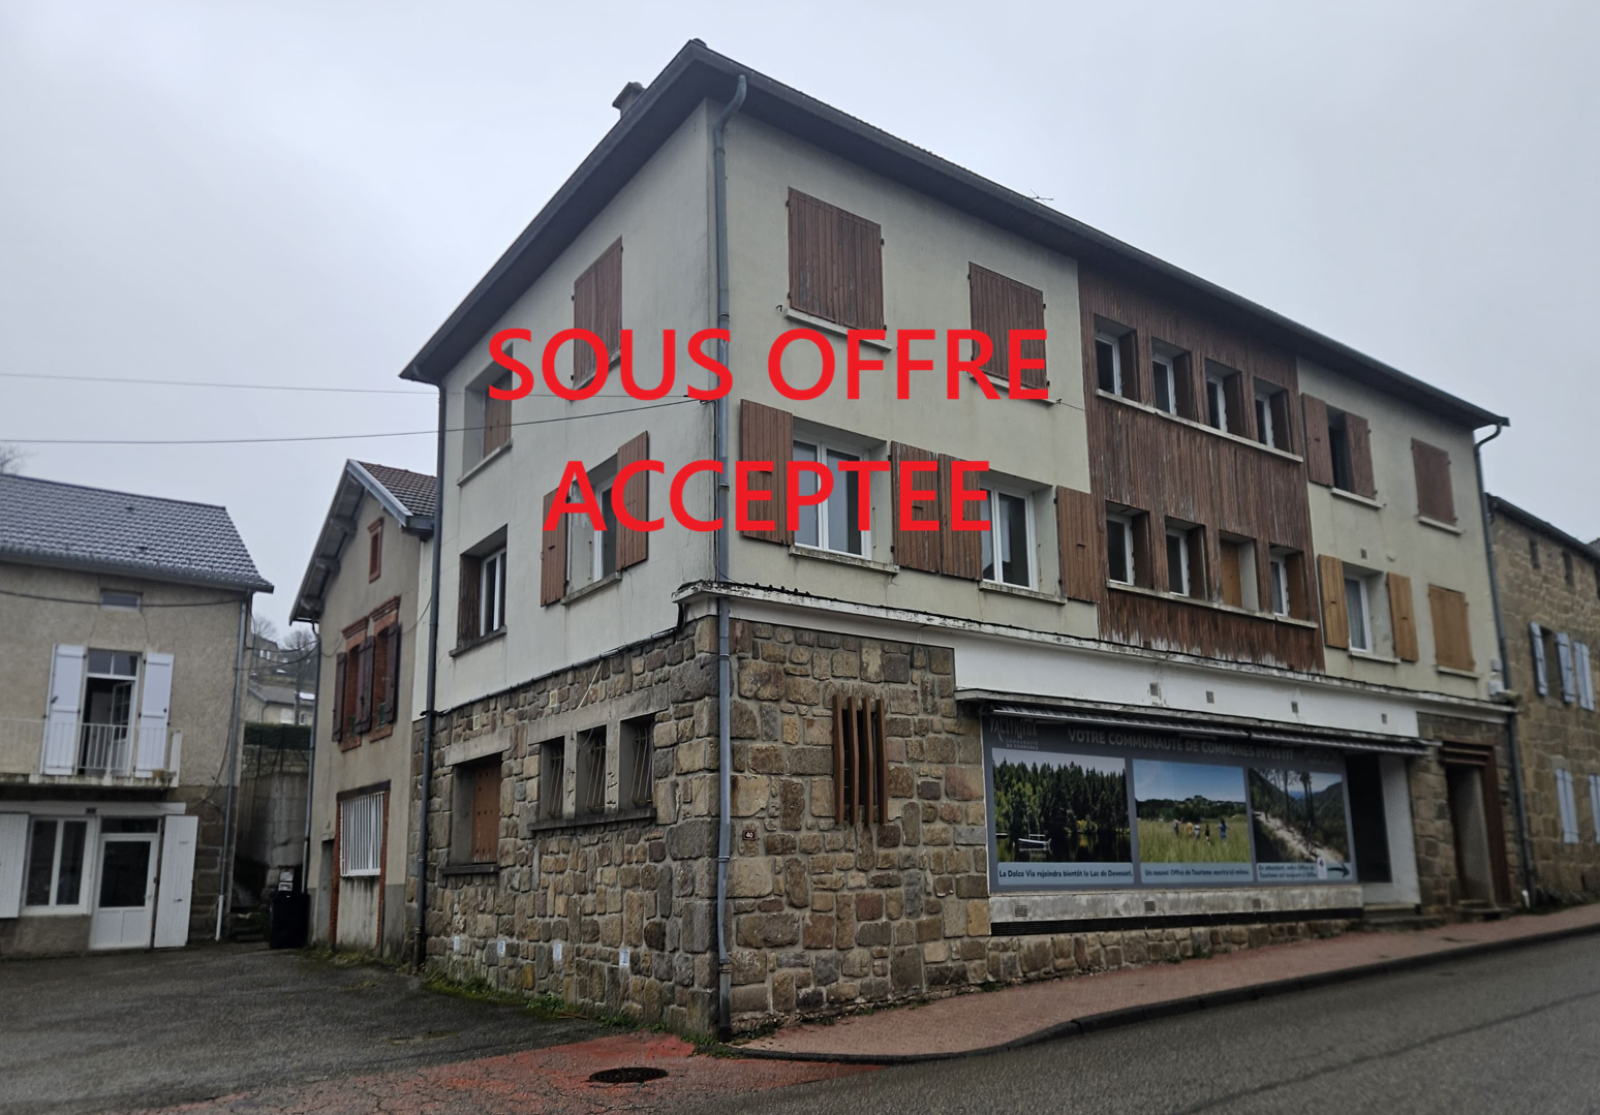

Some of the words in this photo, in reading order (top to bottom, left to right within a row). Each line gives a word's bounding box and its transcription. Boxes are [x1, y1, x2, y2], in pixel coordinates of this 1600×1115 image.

[1067, 728, 1106, 745] VOTRE
[1185, 740, 1199, 752] DE
[1201, 742, 1255, 758] COMMUNES
[1037, 869, 1062, 879] rejoindra
[1090, 869, 1099, 877] Lac
